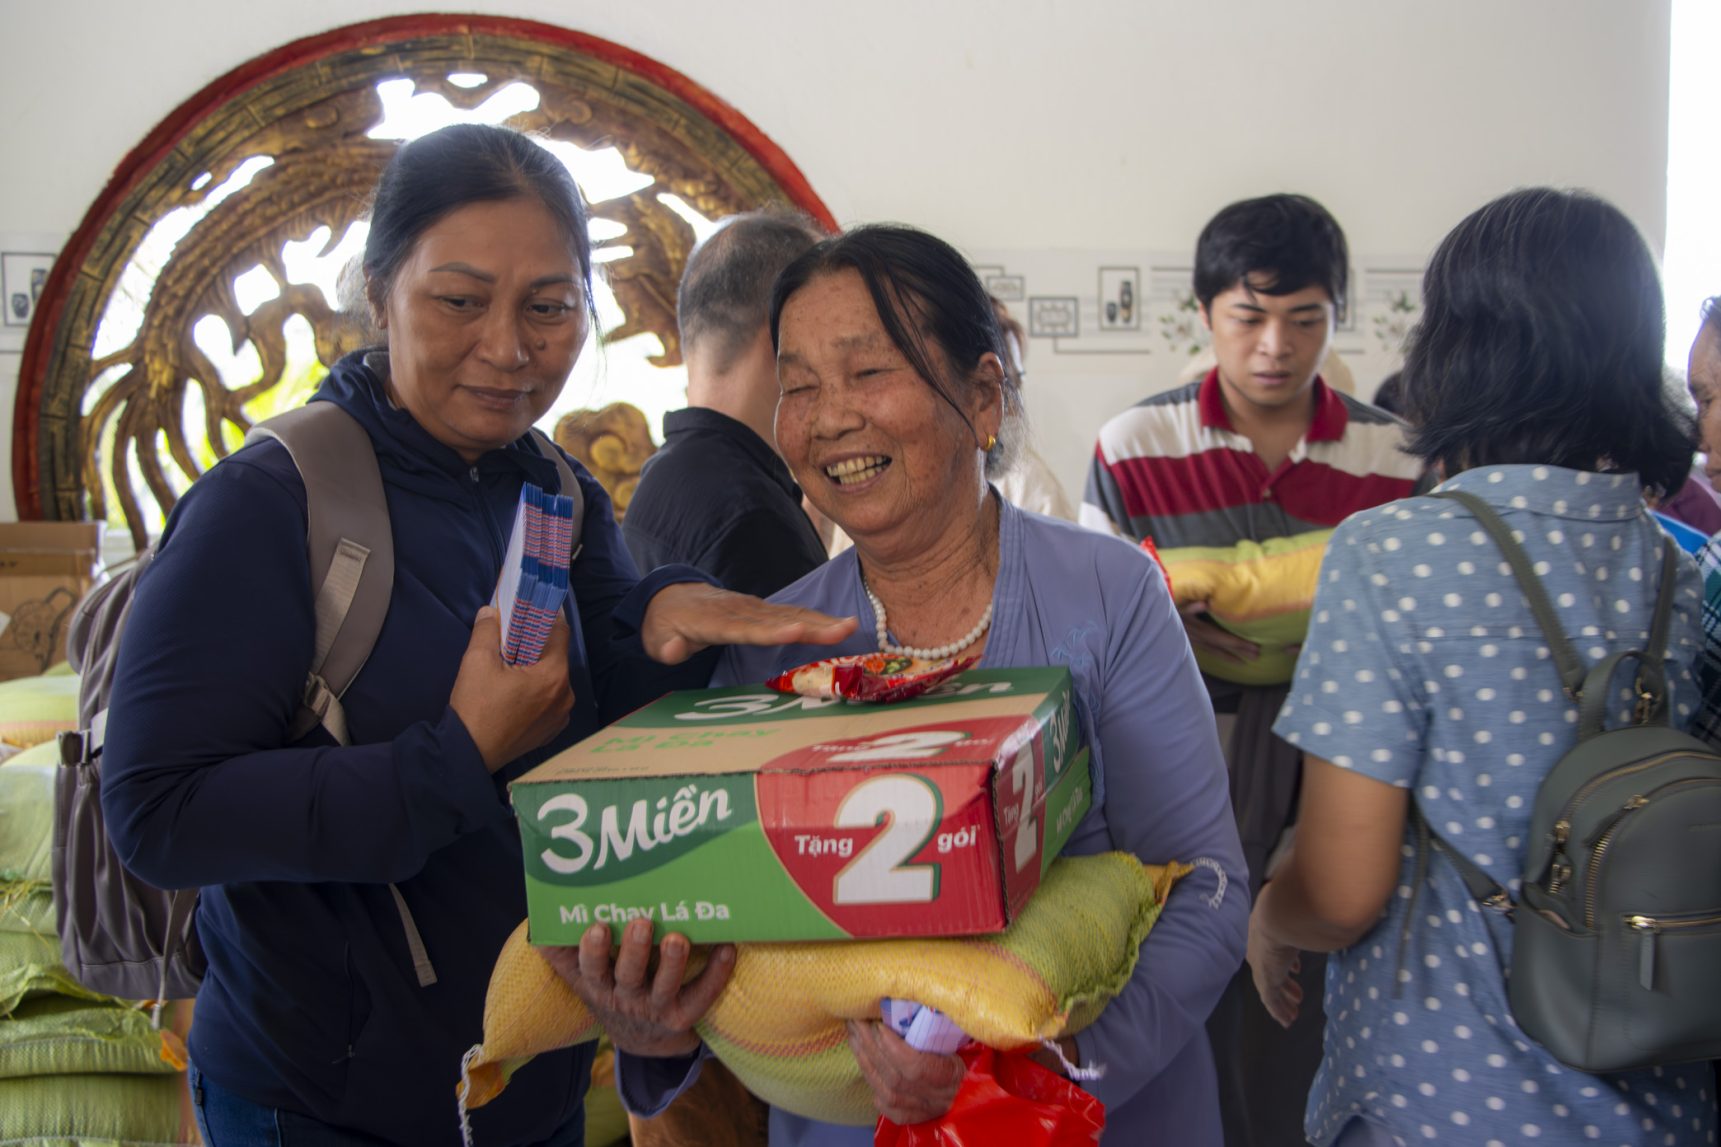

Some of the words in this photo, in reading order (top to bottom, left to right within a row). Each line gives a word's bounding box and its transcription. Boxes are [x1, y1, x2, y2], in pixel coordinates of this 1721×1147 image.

[674, 693, 780, 721] 3
[828, 730, 972, 763] 2
[537, 793, 595, 874] 3
[593, 783, 733, 870] Miền
[1012, 740, 1038, 874] 2
[795, 834, 854, 858] Tặng
[833, 773, 943, 906] 2
[559, 903, 589, 924] Mì
[660, 899, 690, 921] Lá
[695, 901, 731, 920] Đa
